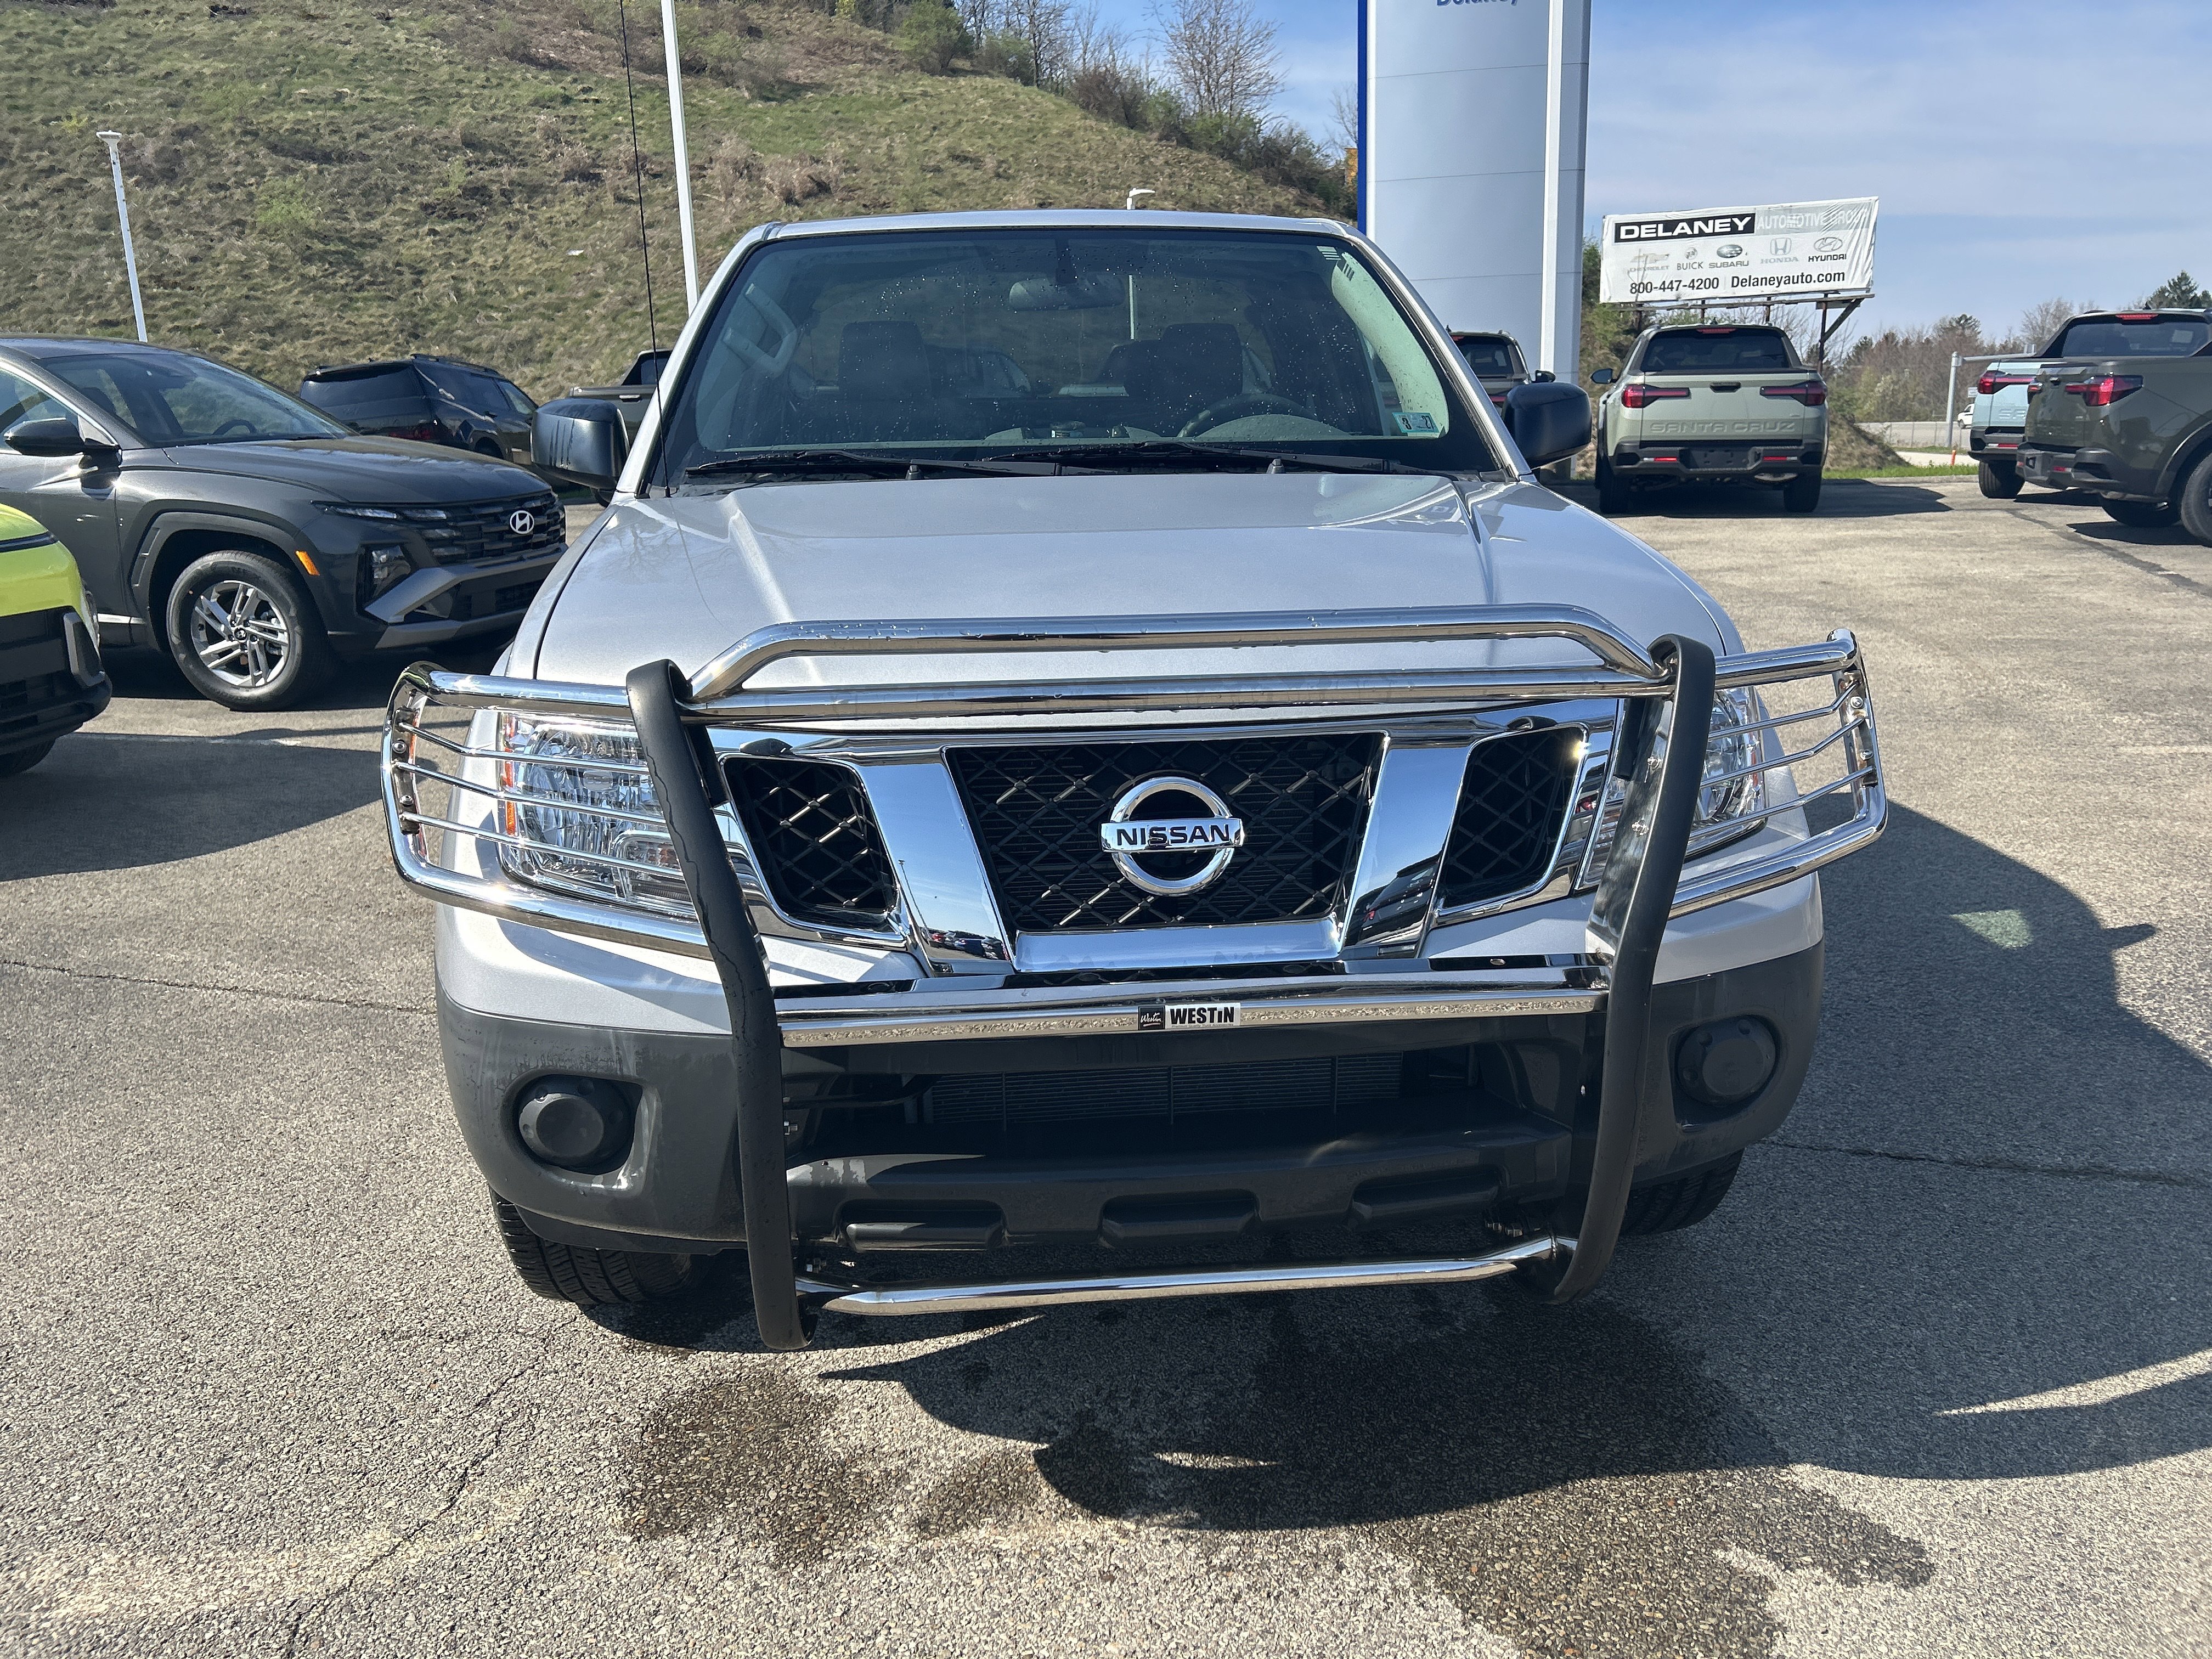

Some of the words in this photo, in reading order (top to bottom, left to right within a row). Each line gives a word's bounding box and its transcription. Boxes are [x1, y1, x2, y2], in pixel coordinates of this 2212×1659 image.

[1620, 217, 1751, 239] DELANEY
[1677, 262, 1703, 270] BUICK
[1808, 254, 1847, 262] HYUNDAI
[1630, 278, 1719, 294] 800-447-4200
[1731, 272, 1845, 288] Delaneyauto.com
[1650, 421, 1727, 433] SANTA
[1733, 421, 1795, 433] CRUZ
[1117, 825, 1229, 845] NISSAN
